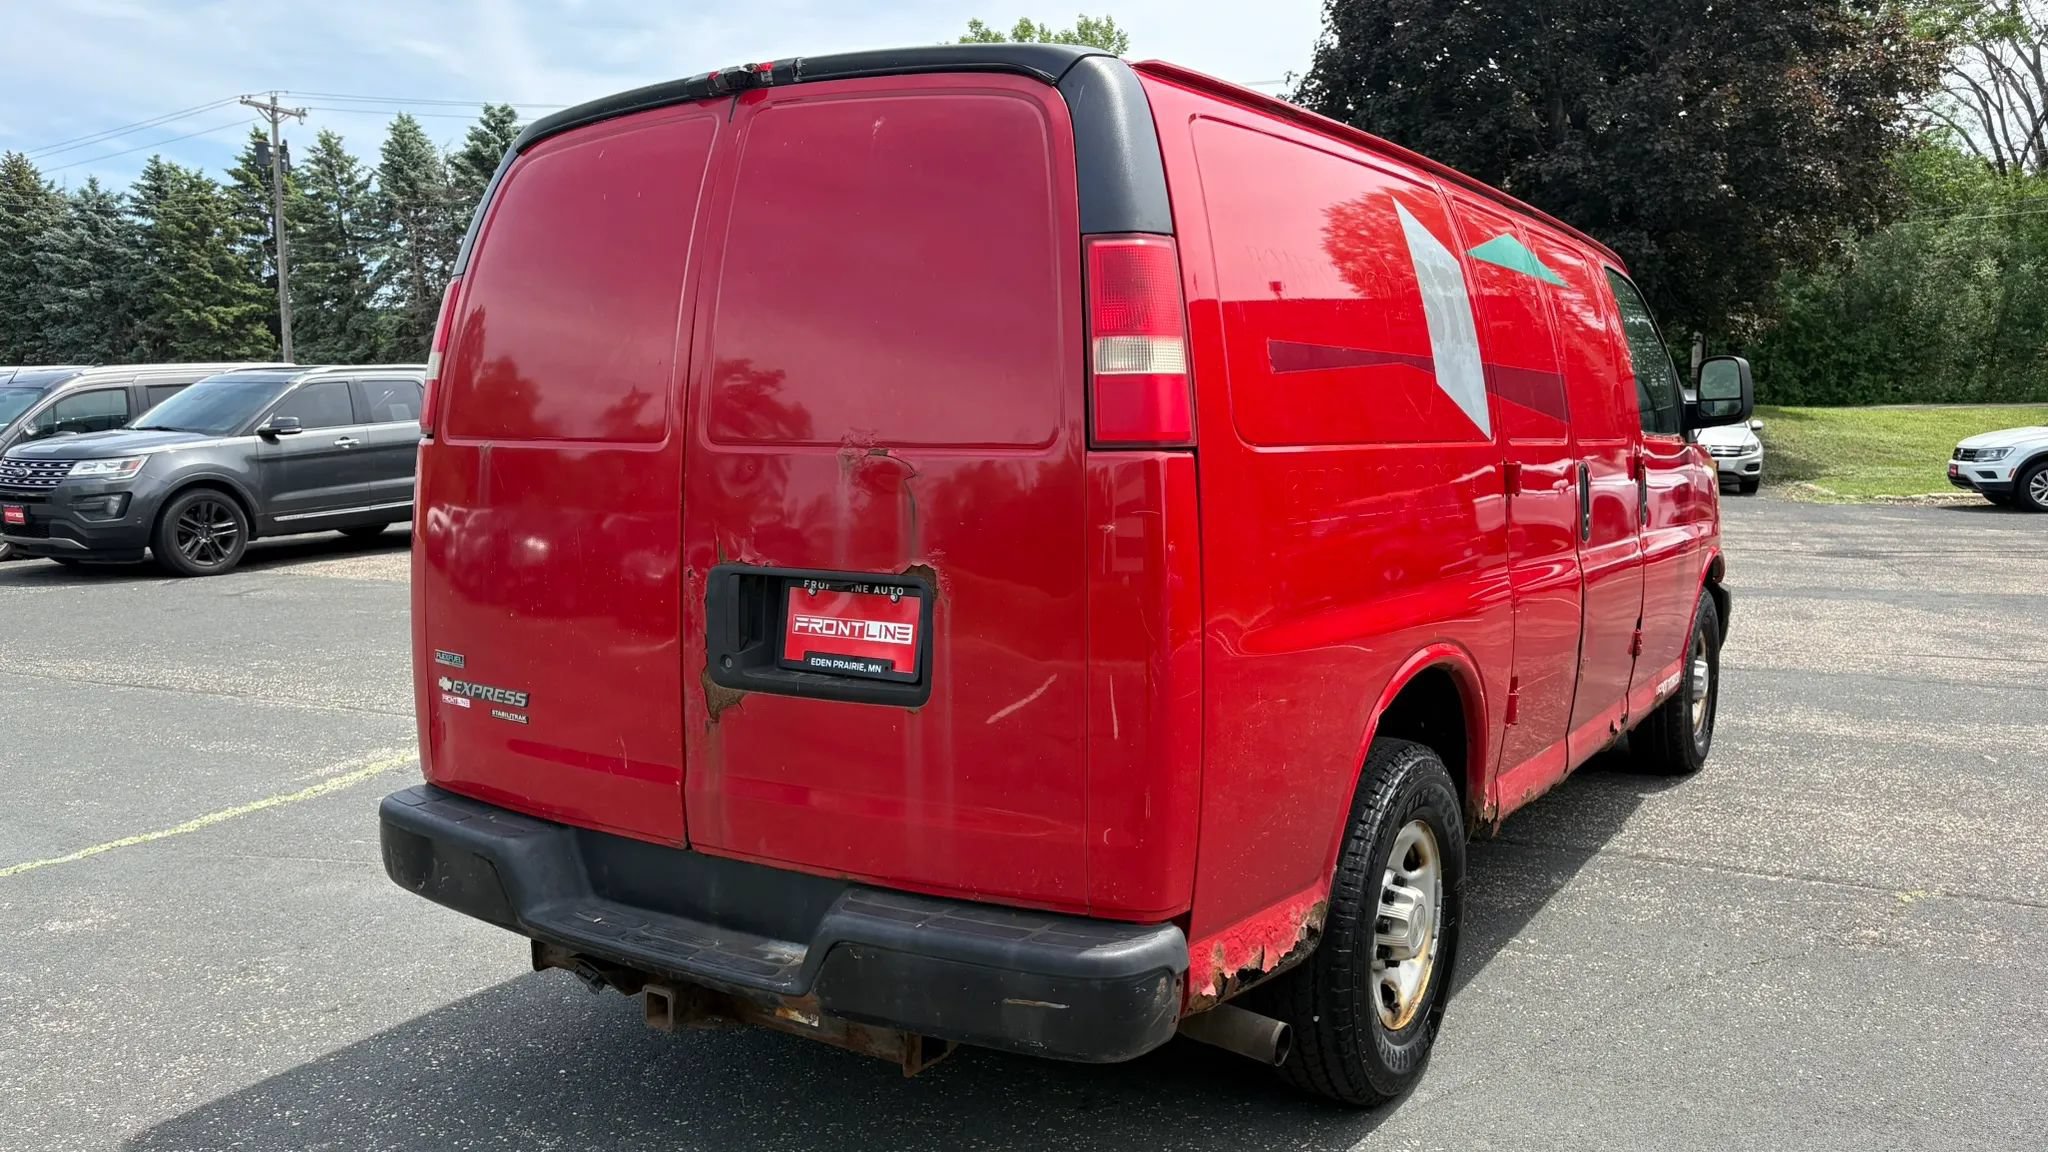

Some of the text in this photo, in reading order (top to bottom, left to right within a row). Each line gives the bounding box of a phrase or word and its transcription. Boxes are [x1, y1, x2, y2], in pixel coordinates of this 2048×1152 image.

[873, 586, 904, 596] AUTO
[794, 617, 911, 642] FRONTLINE
[810, 657, 882, 673] EDEN PRAIRIE, MN
[452, 680, 529, 707] EXPRESS
